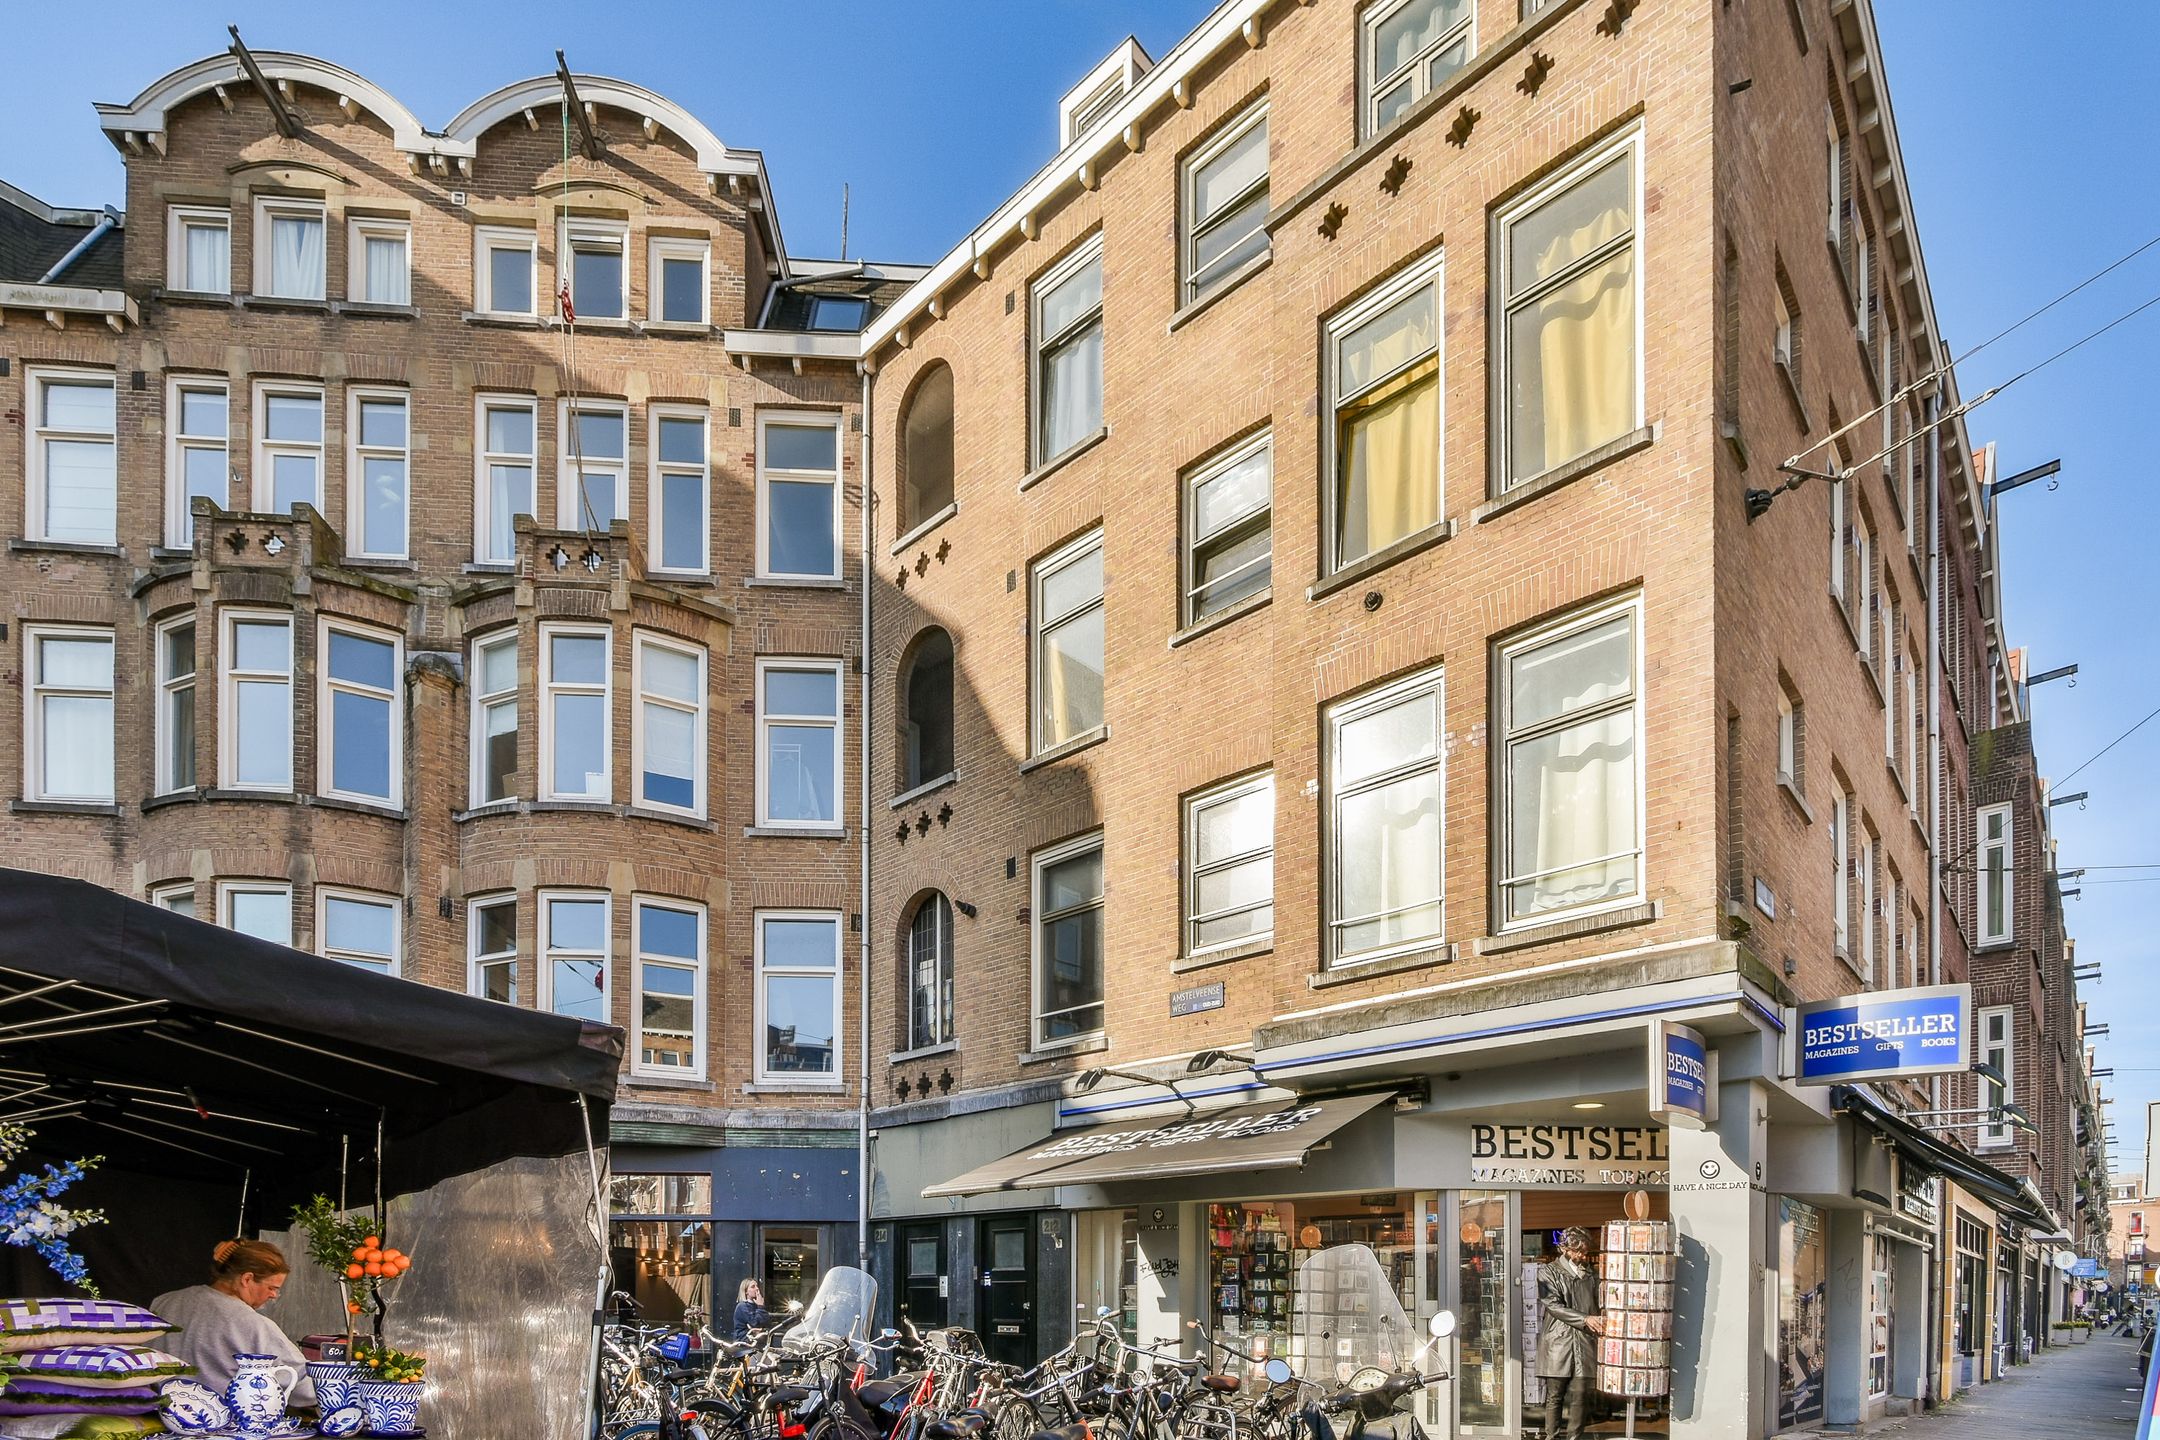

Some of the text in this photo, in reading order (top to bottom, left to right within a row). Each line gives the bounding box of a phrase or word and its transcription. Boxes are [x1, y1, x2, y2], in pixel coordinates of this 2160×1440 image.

[1171, 985, 1220, 1004] AMSTELVEENSE
[1171, 1002, 1187, 1013] WEG
[1805, 1013, 1956, 1047] BESTSELLER
[1805, 1037, 1956, 1060] MAGAZINES GIFTS BOOKS
[1045, 1106, 1323, 1151] BESTSELLER
[1472, 1168, 1585, 1184] MAGAZINES
[1673, 1183, 1697, 1192] HAVE
[1697, 1183, 1705, 1191] A
[1706, 1182, 1728, 1190] NICE
[1729, 1181, 1748, 1190] DAY
